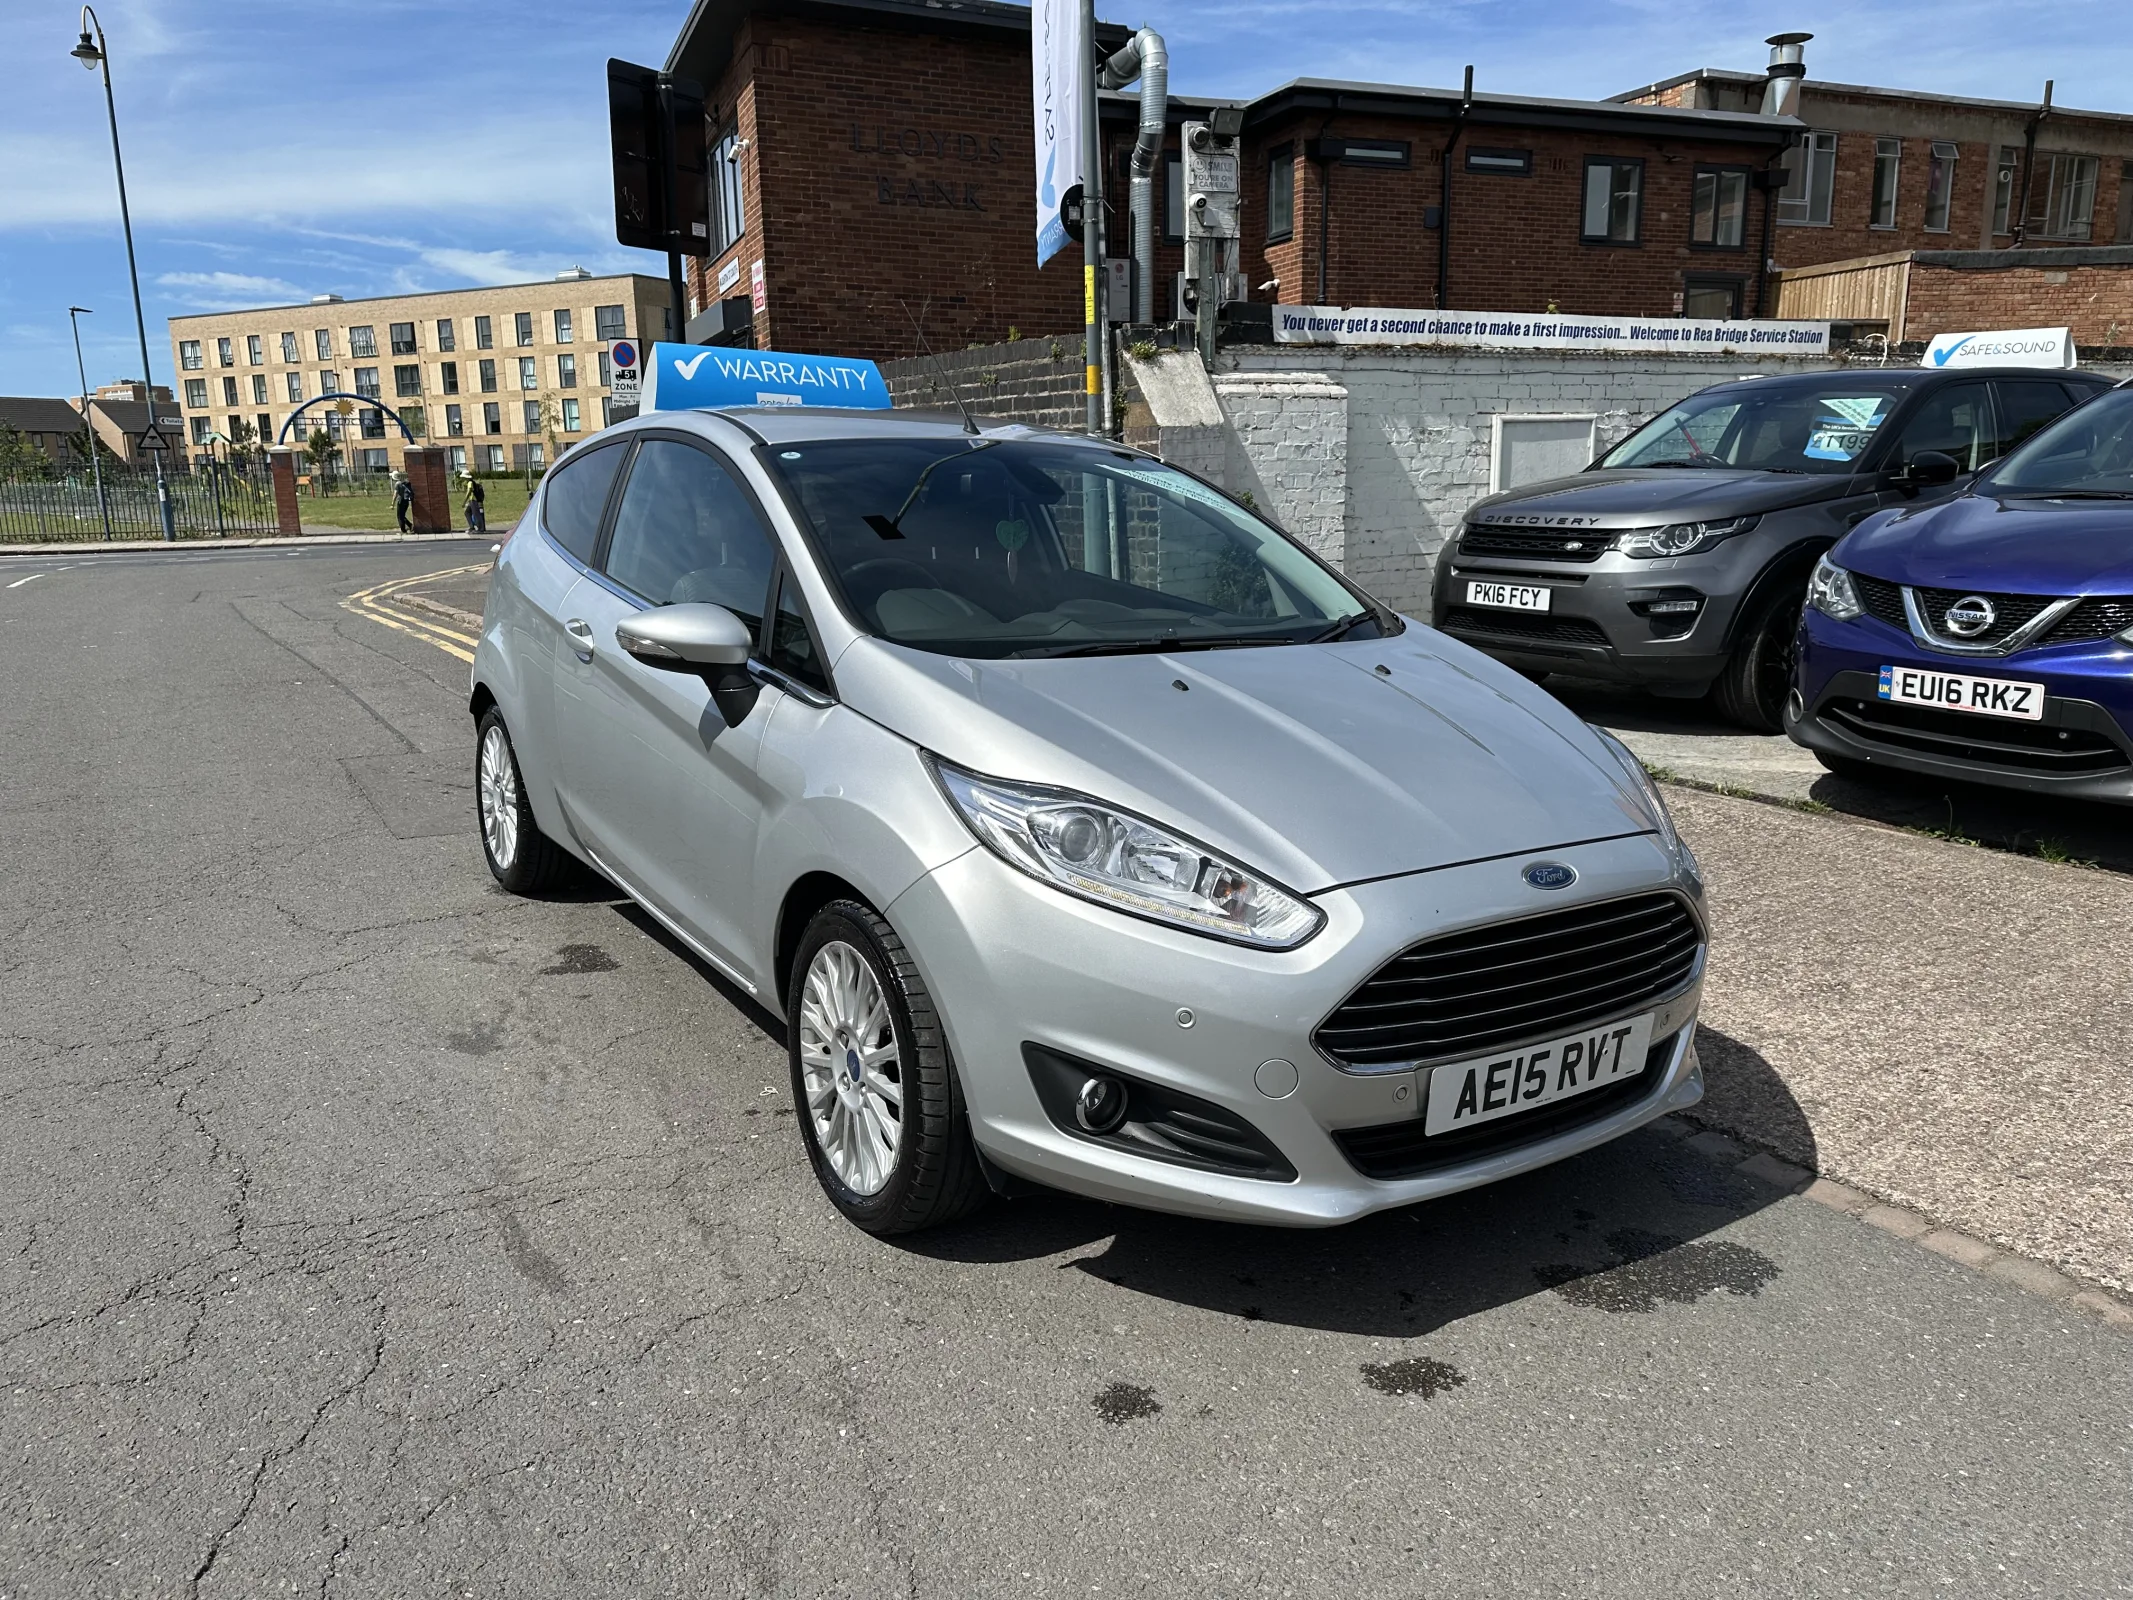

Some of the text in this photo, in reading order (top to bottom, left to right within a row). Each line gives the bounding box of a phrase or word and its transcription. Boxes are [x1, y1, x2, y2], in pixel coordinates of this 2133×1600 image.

[852, 123, 1003, 164] LLOYDS
[1208, 161, 1233, 172] SMILE
[876, 175, 988, 212] BANK
[1282, 314, 1823, 344] You never get a second chance to make a first impression... Welcome to Rea Bridge Service Station
[1959, 341, 2056, 356] SAFE&SOUND
[714, 356, 868, 391] WARRANTY
[1484, 515, 1600, 526] DISCOVERY
[1474, 584, 1541, 607] PK16 FCY
[1948, 611, 1988, 620] NISSAN
[1878, 683, 1890, 694] UK
[1901, 672, 2032, 713] EU16 RKZ
[1536, 867, 1566, 884] Ford
[1453, 1026, 1632, 1119] AE15 RVT
